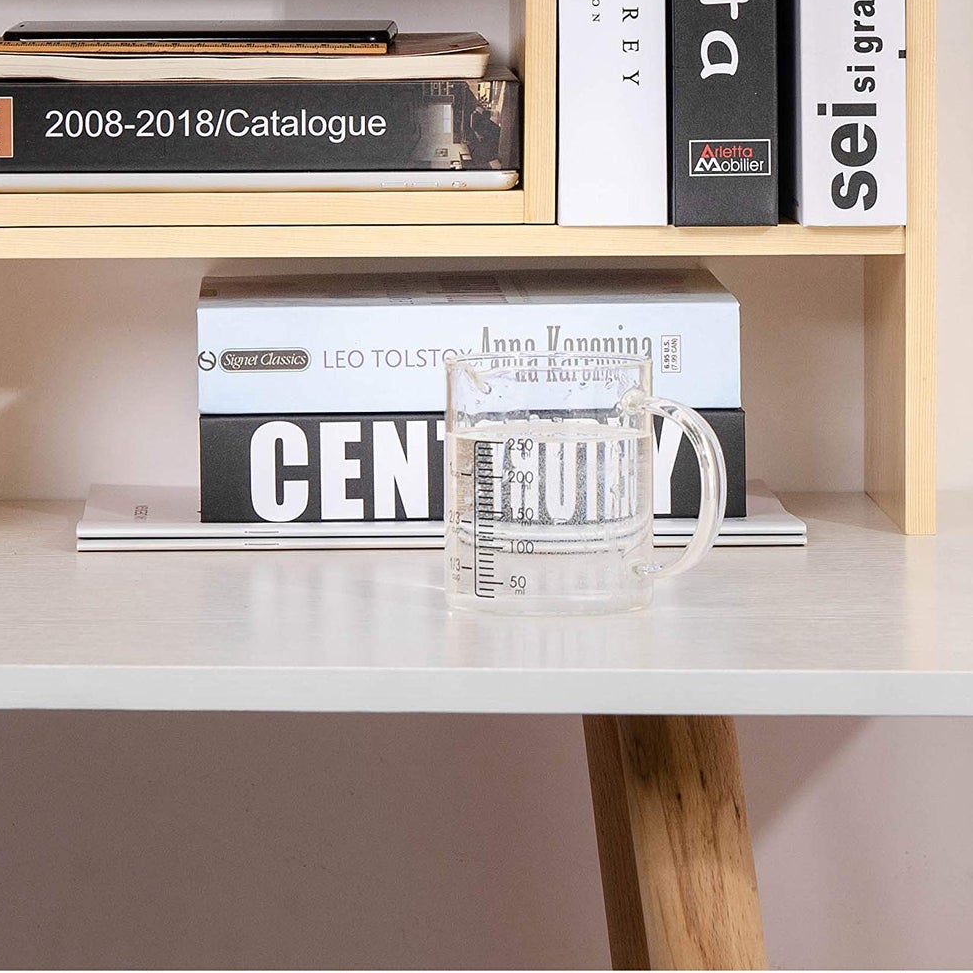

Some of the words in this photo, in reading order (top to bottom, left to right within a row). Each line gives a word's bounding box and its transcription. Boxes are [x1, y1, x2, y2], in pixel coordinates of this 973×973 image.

[846, 65, 876, 93] si
[45, 108, 387, 144] 2008-2018/Catalogue
[700, 143, 754, 158] Arletta
[817, 103, 878, 211] sei
[693, 157, 765, 172] Mobilier
[223, 353, 258, 369] Signet
[259, 352, 307, 366] Classics
[323, 349, 365, 369] LEO
[506, 437, 534, 451] 250
[507, 470, 534, 484] 200
[509, 507, 534, 521] 150
[510, 540, 535, 555] 100
[509, 575, 527, 589] 50
